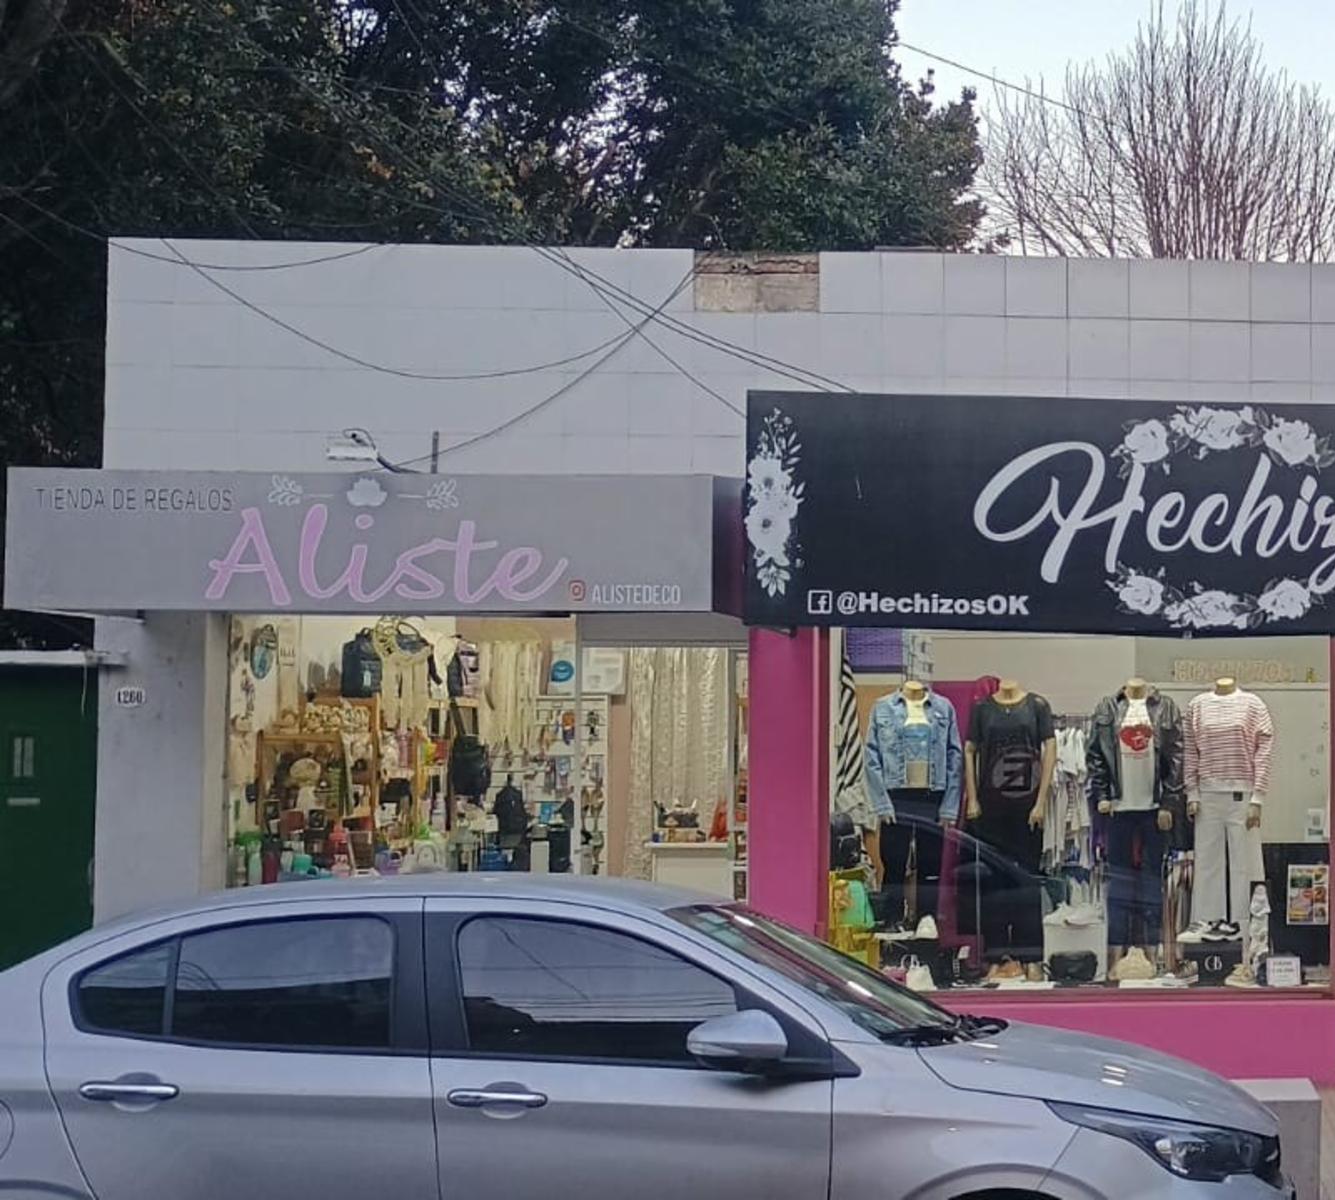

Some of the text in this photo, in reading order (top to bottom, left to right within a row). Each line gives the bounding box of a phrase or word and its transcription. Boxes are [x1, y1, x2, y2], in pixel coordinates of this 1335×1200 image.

[36, 488, 233, 512] TIENDA DE REGALOS
[205, 503, 569, 606] Aliste
[591, 584, 681, 605] ALISTEDECO
[836, 591, 1030, 616] @HechizosOK
